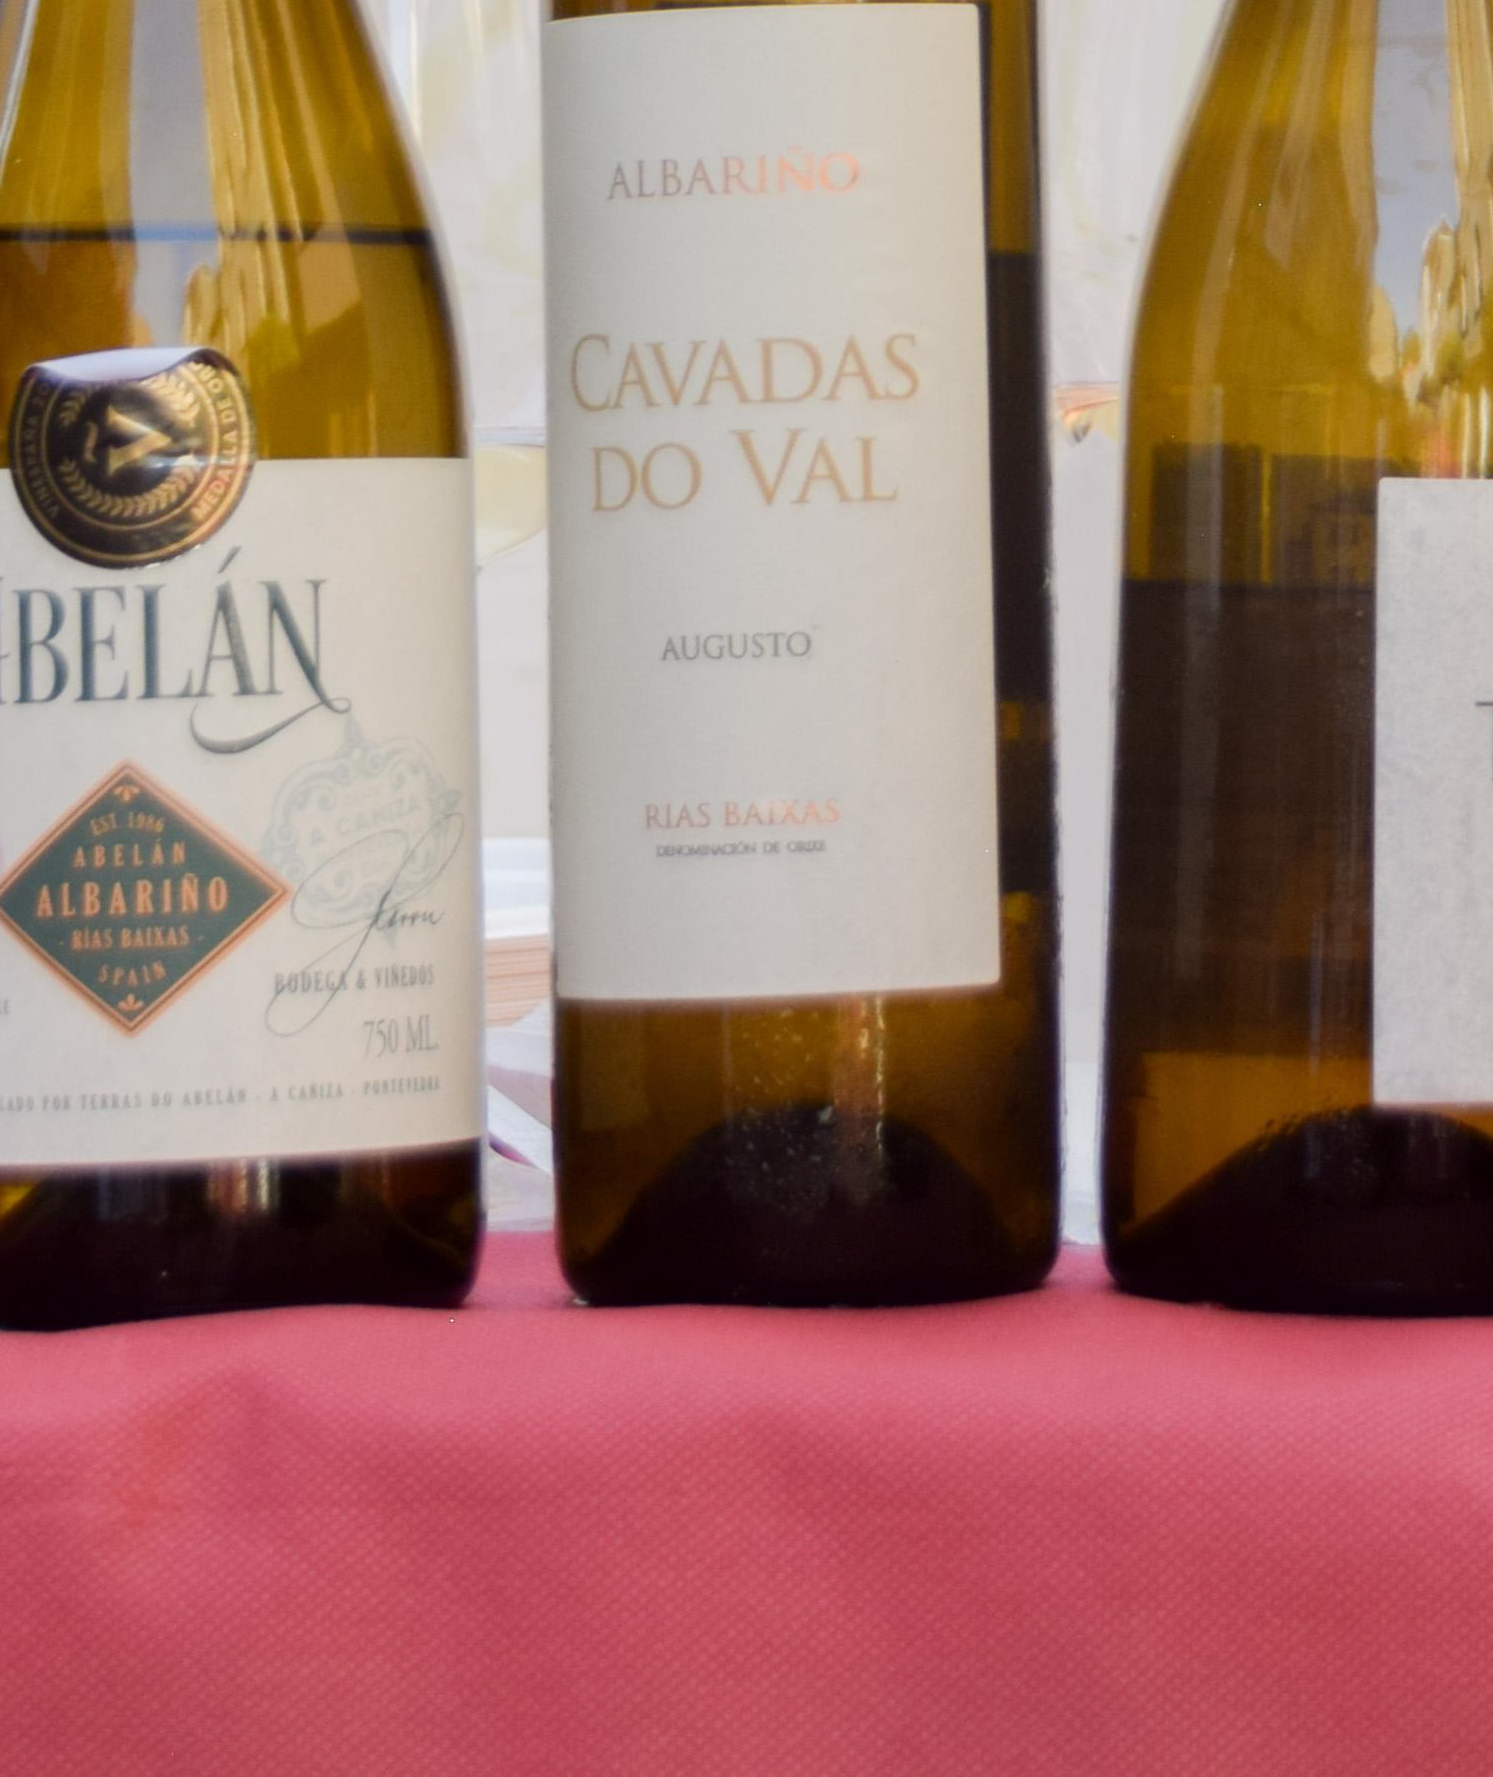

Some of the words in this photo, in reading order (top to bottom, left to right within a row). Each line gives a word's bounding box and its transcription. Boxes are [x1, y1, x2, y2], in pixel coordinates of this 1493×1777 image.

[607, 147, 862, 201] ALBARIÑO
[570, 332, 920, 413] CAVADAS
[589, 441, 703, 512] DO
[730, 427, 899, 507] VAL
[660, 631, 812, 662] AUGUSTO
[722, 798, 842, 828] BAIXAS
[72, 838, 186, 869] ABELÁN
[762, 841, 781, 855] DE
[36, 873, 230, 918] ALBARIÑO
[120, 924, 190, 949] BAIXAS
[98, 960, 168, 987] SPAIN
[273, 969, 348, 994] BODEGA
[374, 963, 435, 989] VIÑEDOS
[363, 1018, 399, 1058] 750
[41, 1094, 72, 1112] POR
[80, 1092, 143, 1111] TERRAS
